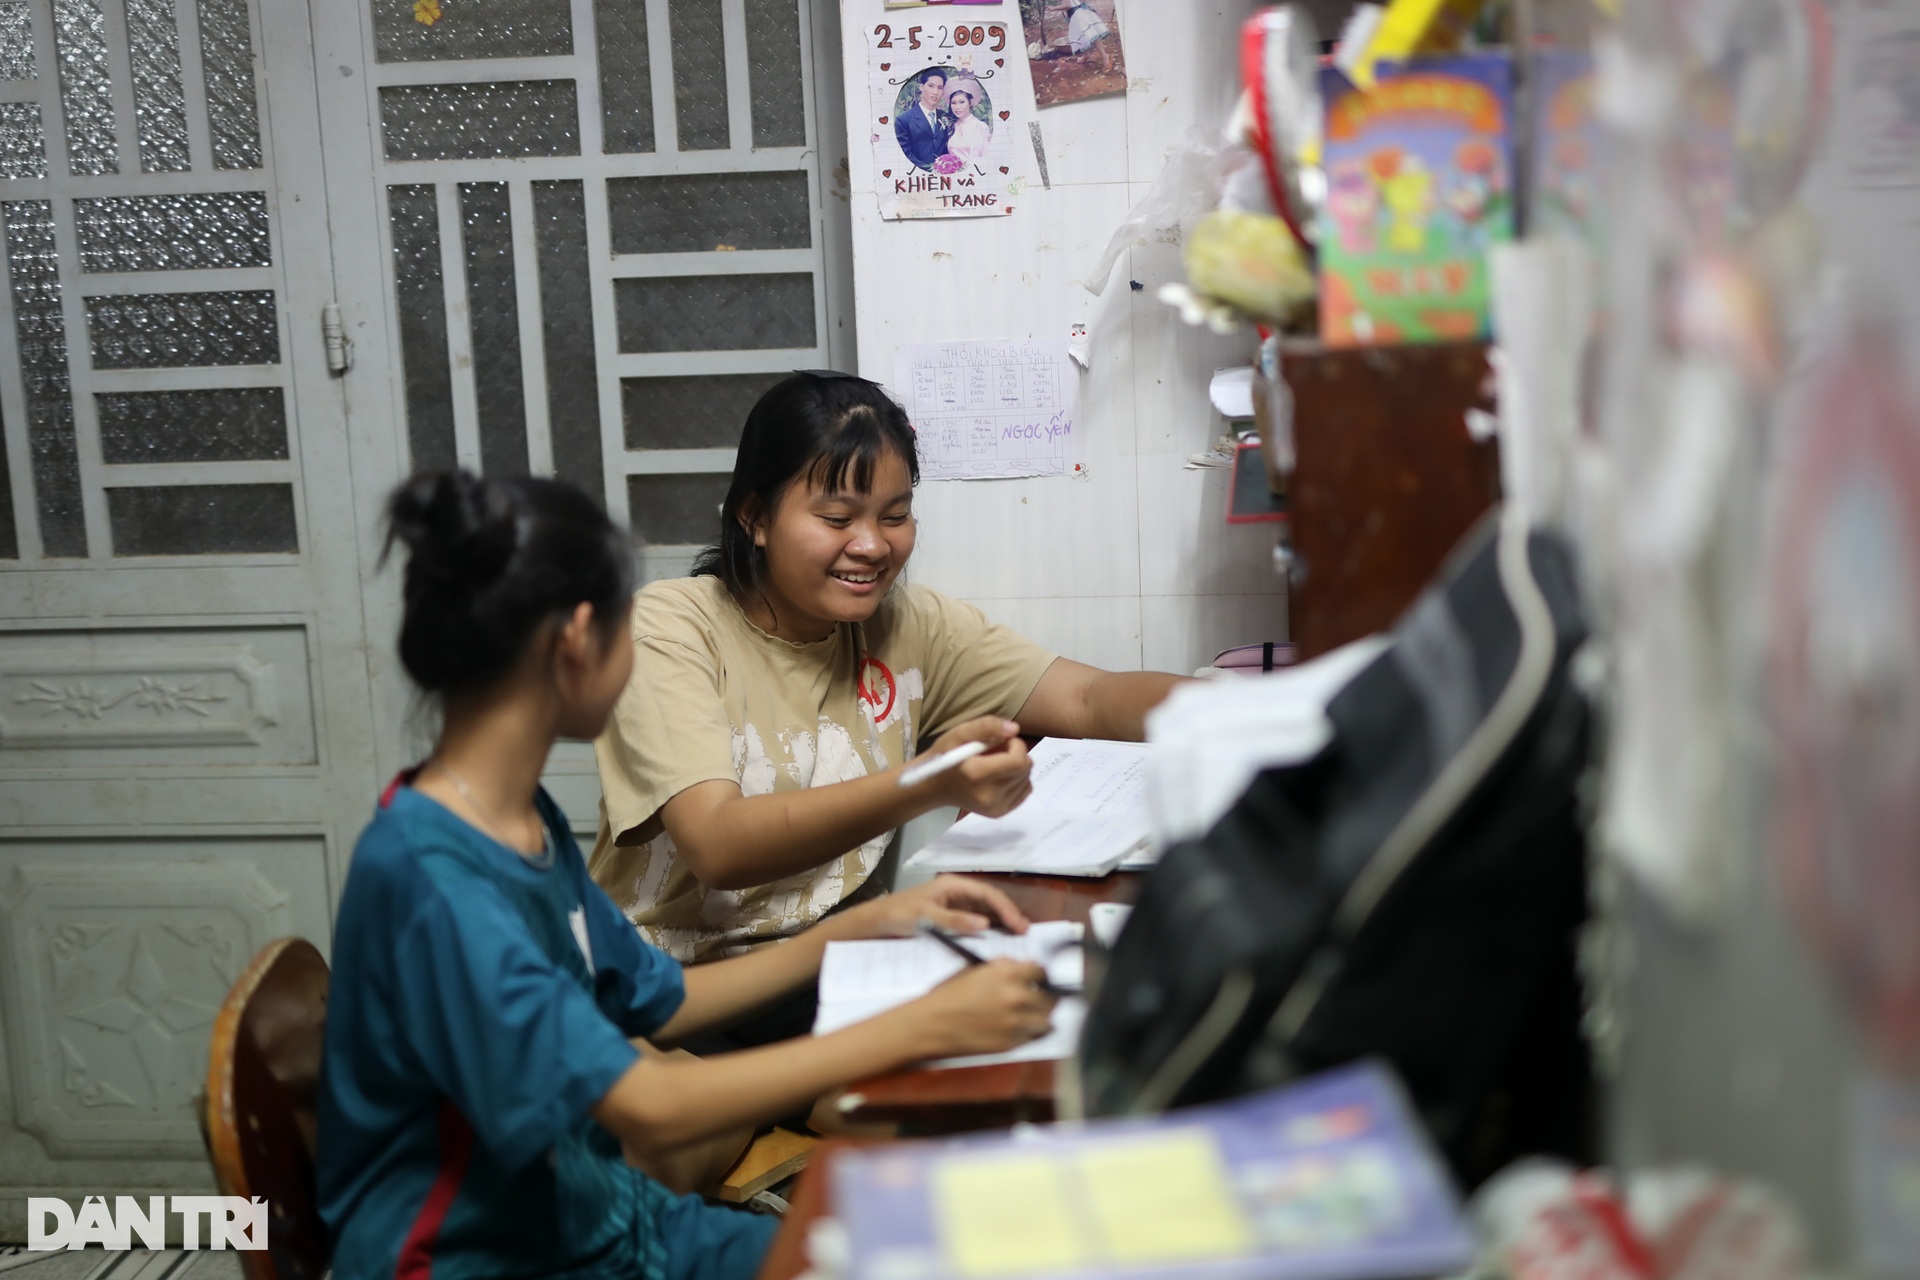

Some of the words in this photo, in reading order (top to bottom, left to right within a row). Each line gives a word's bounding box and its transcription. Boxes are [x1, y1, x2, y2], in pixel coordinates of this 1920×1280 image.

[874, 23, 1006, 52] 2-5-2009
[936, 194, 997, 207] TRANG
[1002, 422, 1042, 444] NGỌC
[1045, 409, 1073, 443] YẾN
